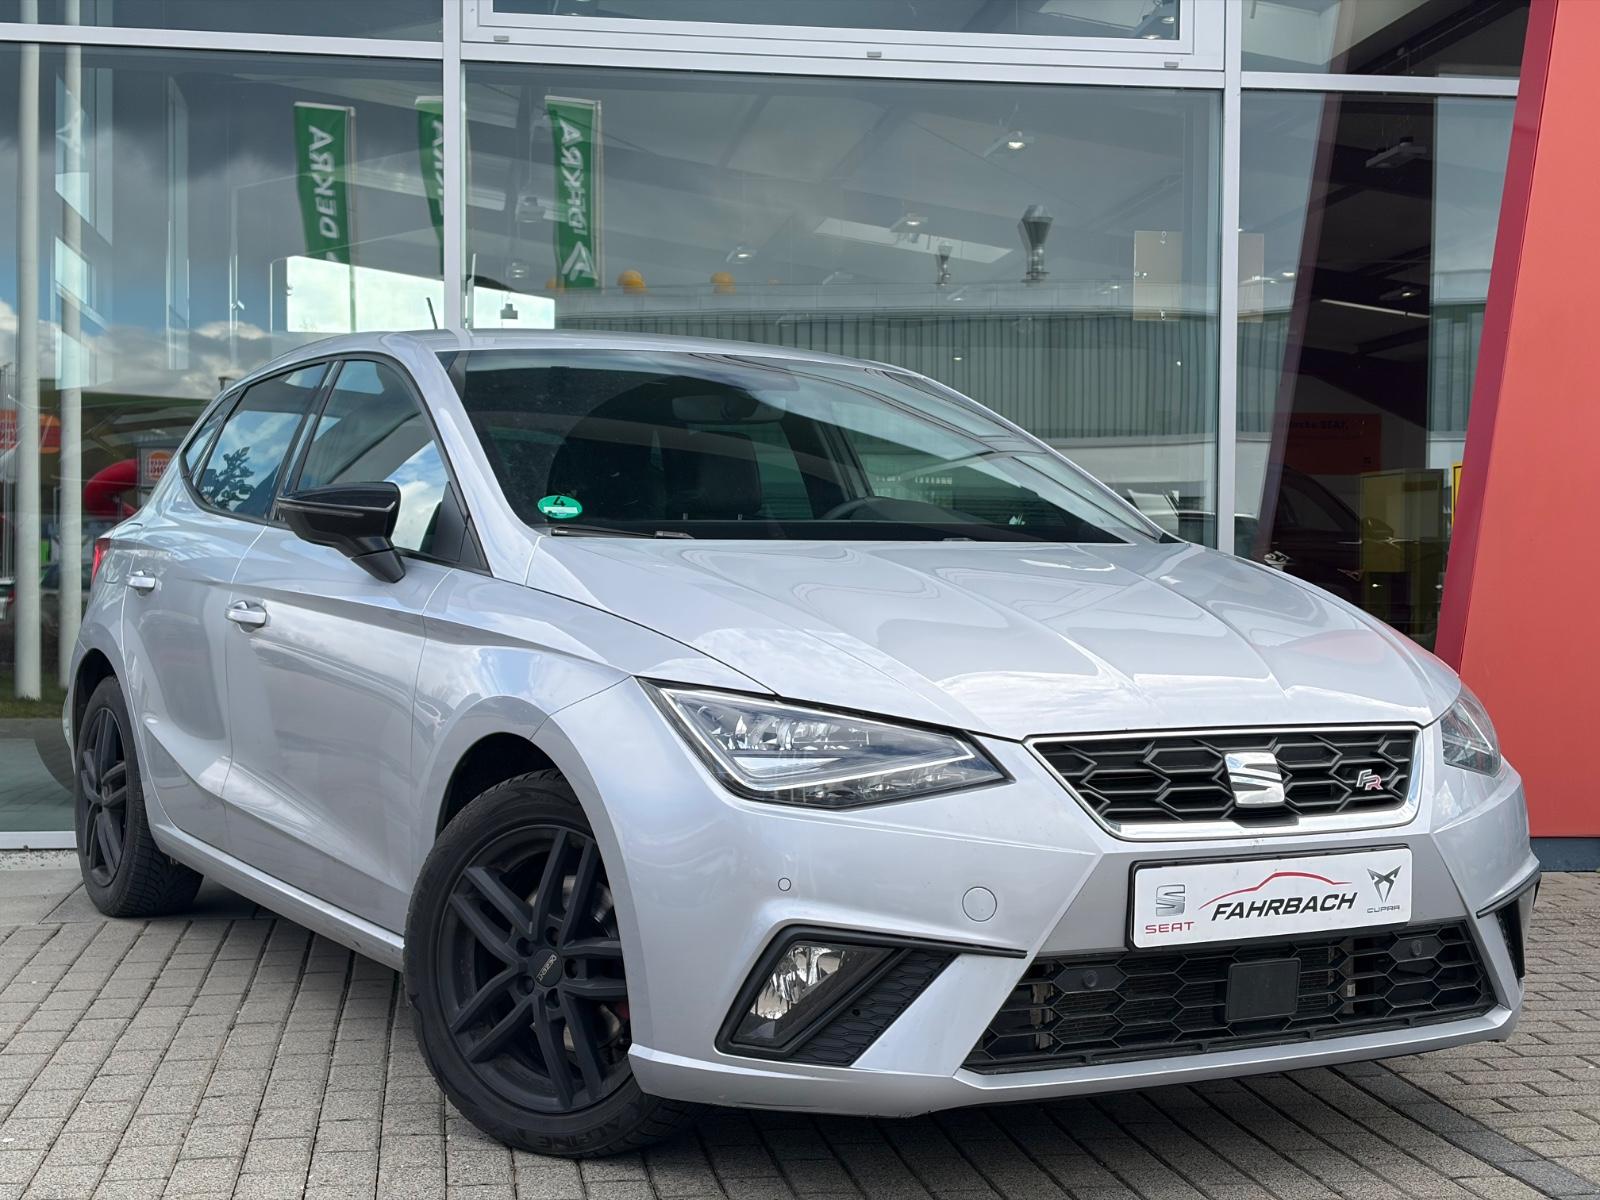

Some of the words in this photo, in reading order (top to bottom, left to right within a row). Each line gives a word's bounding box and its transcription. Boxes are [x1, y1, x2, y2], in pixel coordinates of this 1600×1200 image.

[1355, 768, 1384, 791] FR
[1211, 891, 1358, 922] FAHRBACH
[1366, 904, 1400, 914] CUPRA
[1145, 921, 1195, 935] SEAT
